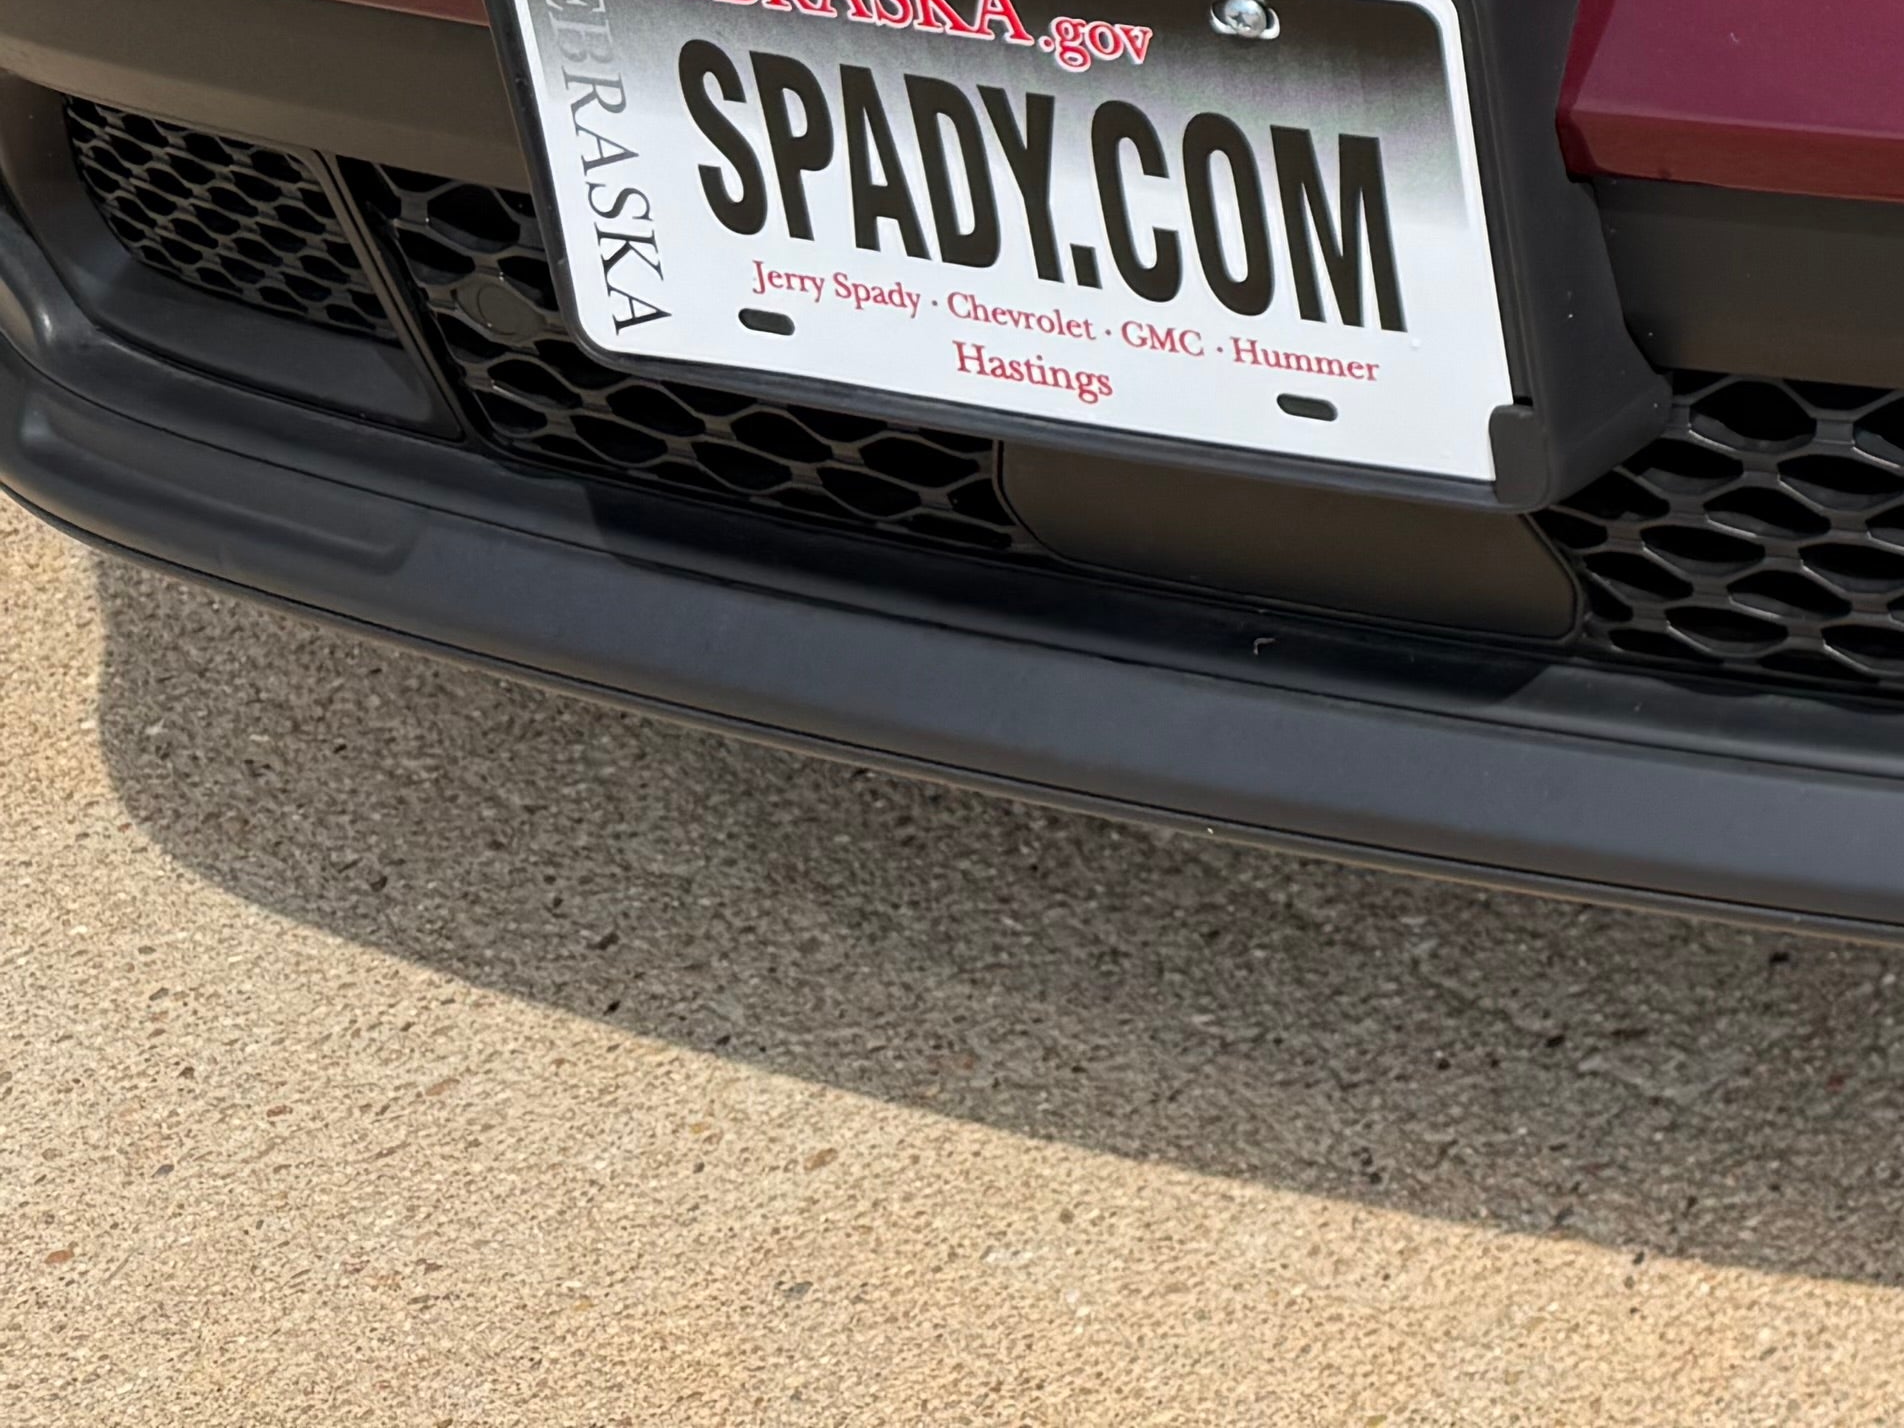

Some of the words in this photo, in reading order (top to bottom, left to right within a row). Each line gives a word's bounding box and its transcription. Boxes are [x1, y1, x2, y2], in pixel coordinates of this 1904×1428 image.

[678, 38, 1409, 333] SPADY.COM
[751, 259, 825, 303] Jerry
[834, 272, 921, 318] Spady
[947, 291, 1096, 341] Chevrolet
[1121, 320, 1205, 357] GMC
[1229, 336, 1380, 382] Hummer
[952, 340, 1114, 405] Hastings
